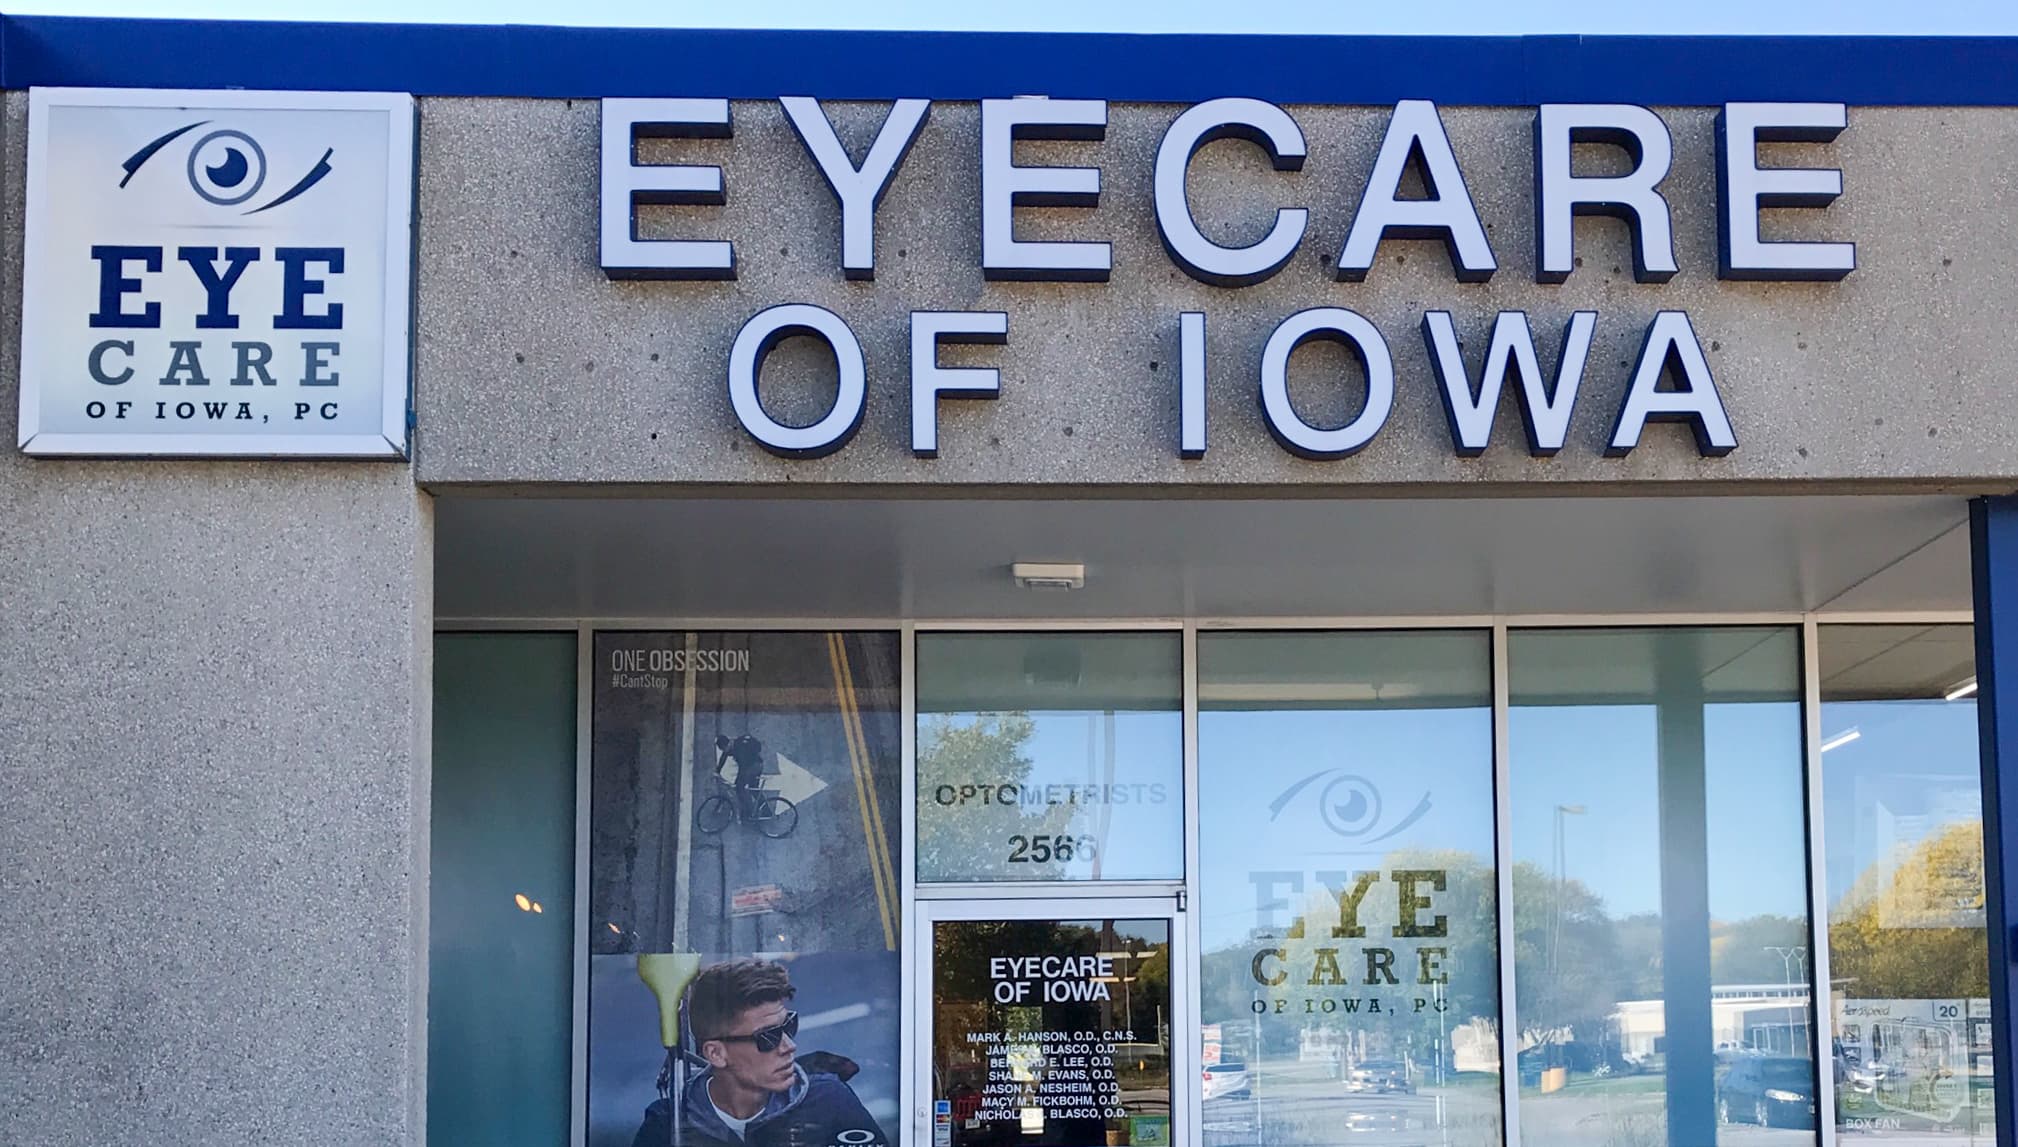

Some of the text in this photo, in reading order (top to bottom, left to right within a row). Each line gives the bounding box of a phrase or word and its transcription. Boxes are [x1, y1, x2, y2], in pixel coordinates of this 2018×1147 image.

[600, 97, 1856, 286] EYECARE
[89, 245, 345, 329] EYE
[88, 340, 340, 387] CARE
[728, 303, 1739, 459] OF IOWA
[86, 401, 339, 424] OF IOWA, PC
[612, 650, 750, 672] ONE OBSESSION
[612, 674, 669, 690] #CantStop
[935, 783, 1167, 806] OPTOMETRISTS
[1008, 834, 1098, 864] 2566
[1249, 870, 1448, 939] EYE
[990, 955, 1113, 980] EYECARE
[1251, 947, 1449, 986] CARE
[994, 980, 1111, 1003] OF IOWA
[1251, 998, 1448, 1016] OF IOWA, PC
[967, 1030, 1137, 1042] MARK A. HANSON, O.D., C.N.S.
[1042, 1043, 1093, 1055] BLASCO,
[1095, 1043, 1118, 1054] O.D.
[990, 1056, 1114, 1068] BERRD E. LEE, O.D.
[1032, 1070, 1045, 1081] M.
[1048, 1069, 1089, 1081] EVANS,
[1092, 1069, 1115, 1080] O.D.
[982, 1082, 1121, 1094] JASON A. NESHEIM, O.D.
[981, 1095, 1122, 1107] MACY M. FICKBOHM, O.D.
[1050, 1108, 1101, 1120] BLASCO,
[1104, 1107, 1128, 1118] O.D.
[1846, 1118, 1900, 1129] BOX FAN
